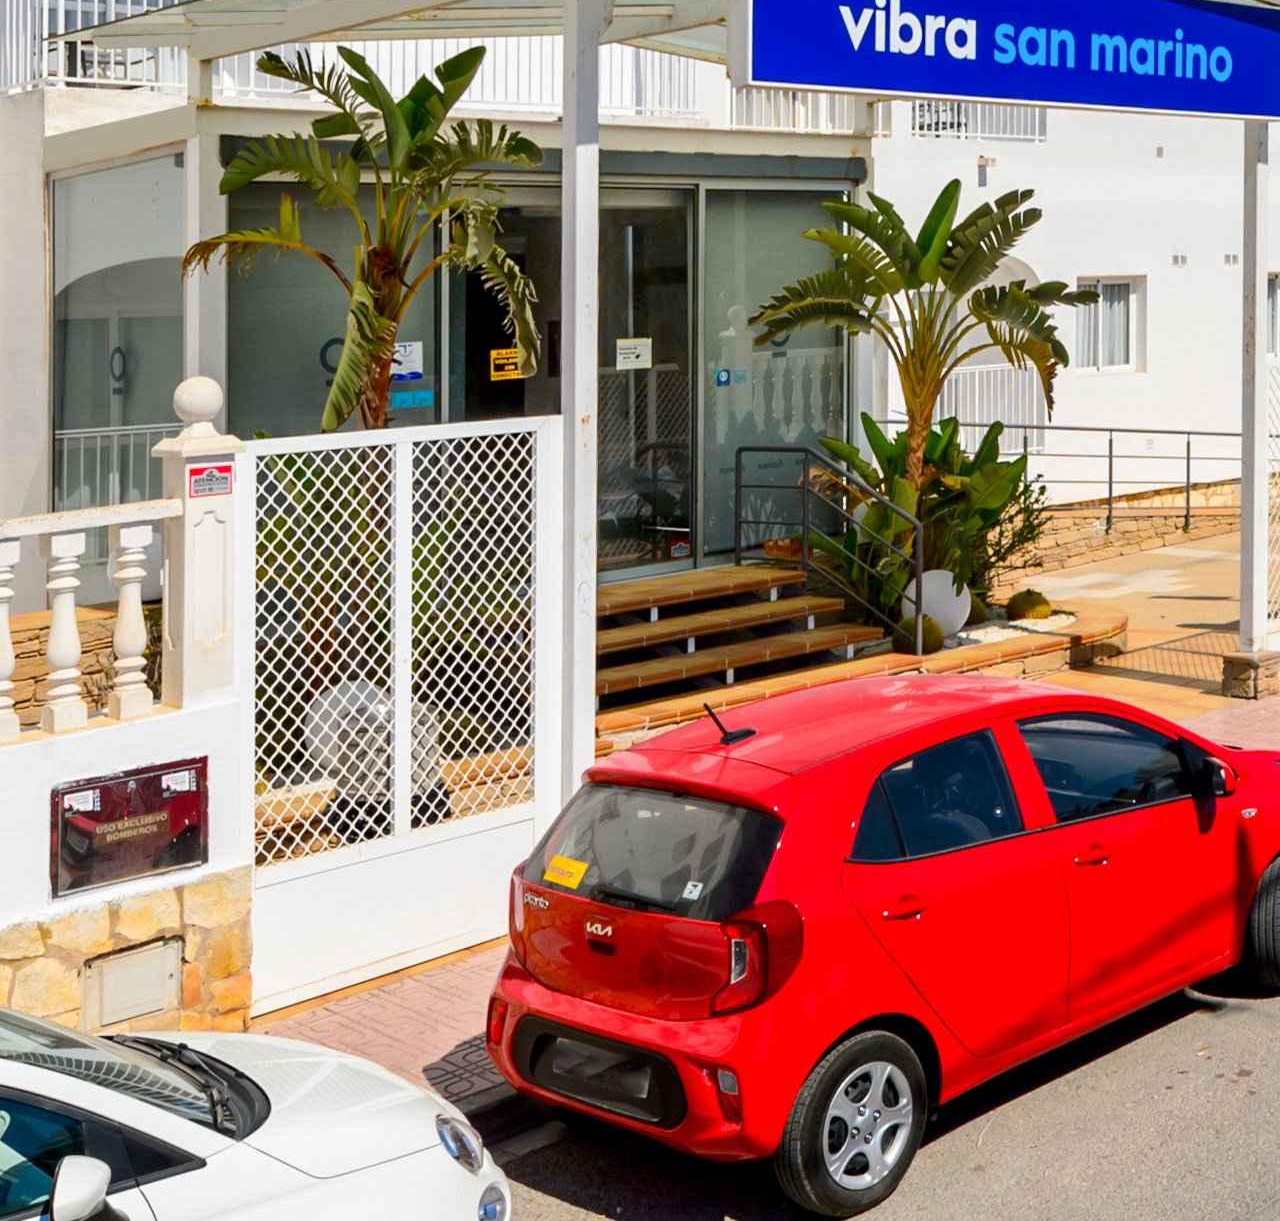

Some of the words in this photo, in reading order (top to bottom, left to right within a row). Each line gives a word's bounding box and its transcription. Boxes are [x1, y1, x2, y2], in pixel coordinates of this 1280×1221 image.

[993, 23, 1076, 69] san
[1090, 28, 1234, 83] marino
[96, 823, 116, 834] USO
[117, 813, 168, 830] EXCLUSIVO
[106, 824, 158, 842] BOMBEROS
